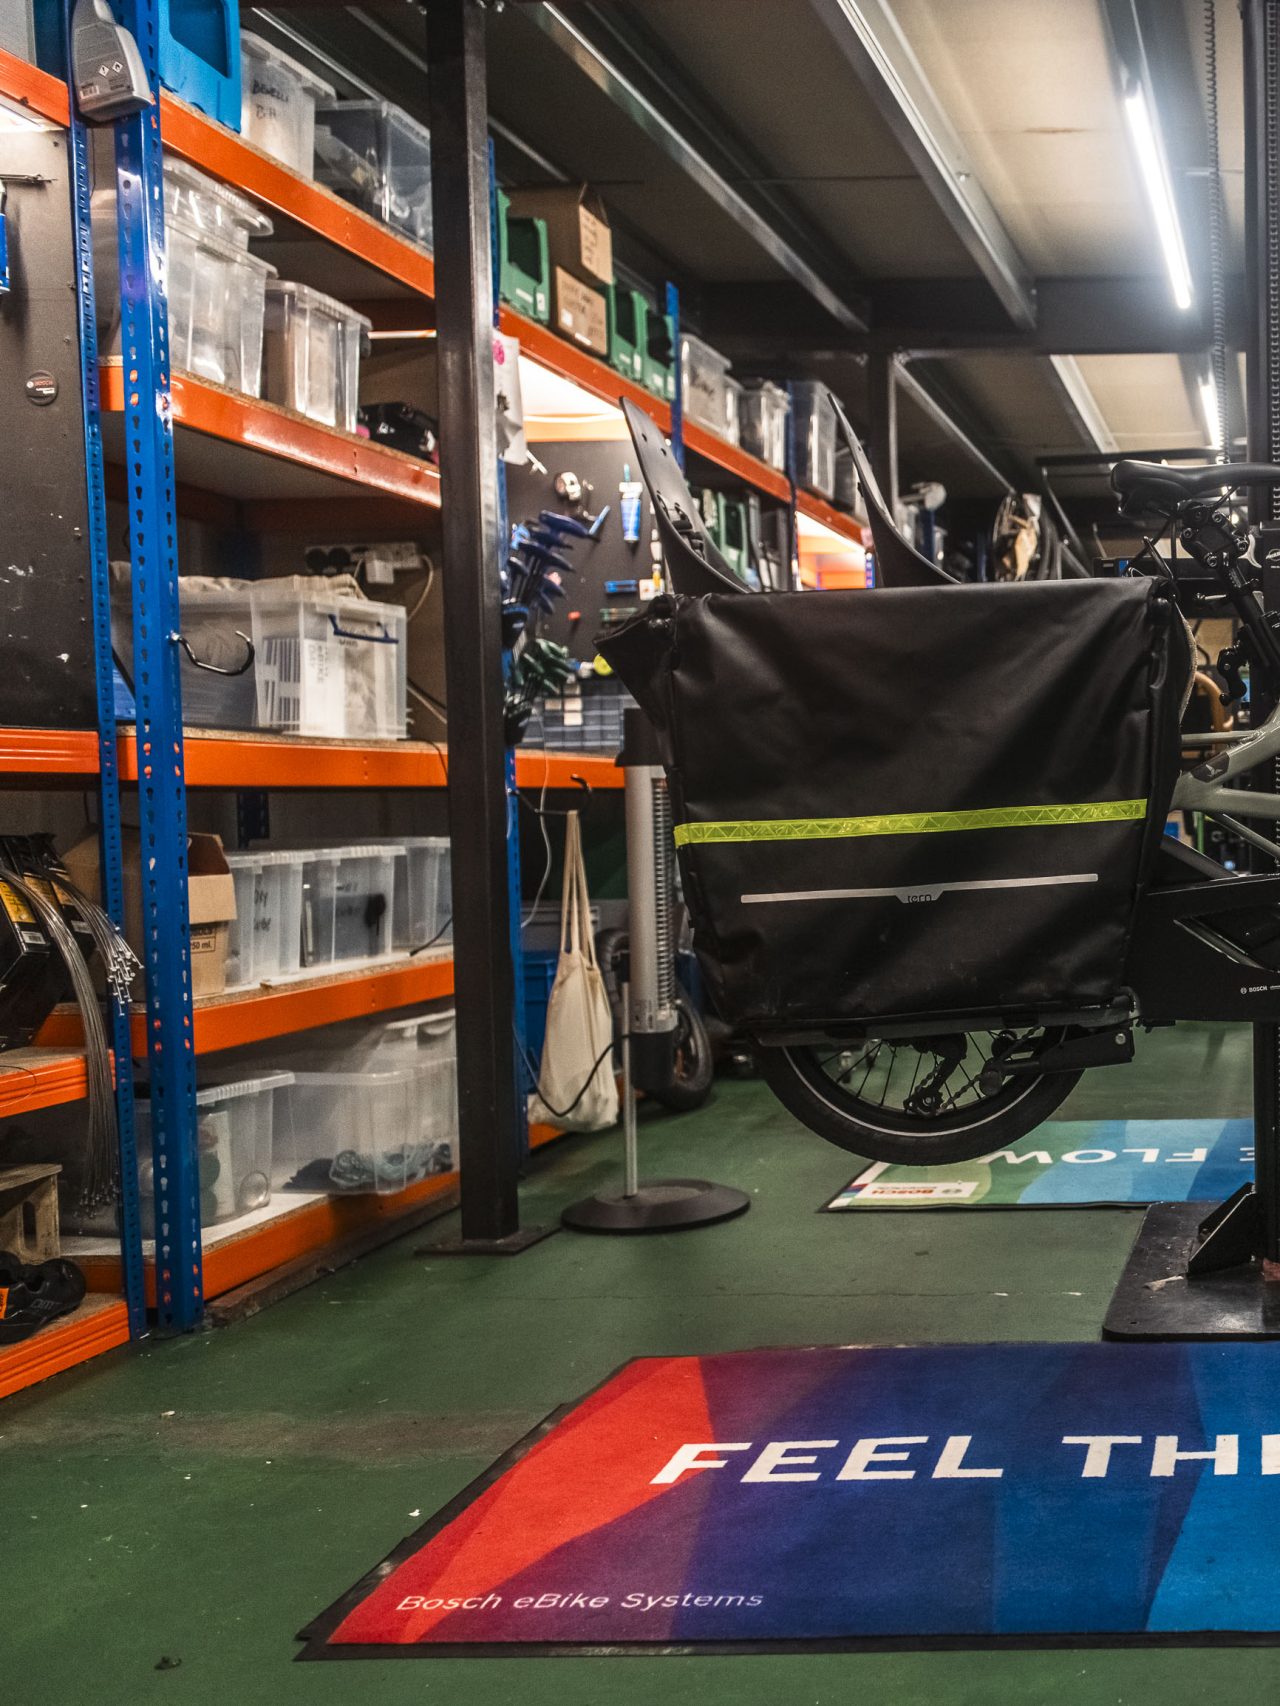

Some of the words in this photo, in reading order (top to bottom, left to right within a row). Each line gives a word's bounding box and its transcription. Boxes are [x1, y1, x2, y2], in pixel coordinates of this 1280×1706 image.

[907, 894, 932, 903] tern
[1248, 985, 1268, 993] BOSCH
[976, 1148, 1208, 1164] FLOW
[649, 1435, 1004, 1485] FEEL
[395, 1594, 503, 1610] Bosch
[513, 1594, 610, 1609] eBike
[620, 1593, 764, 1612] Systems
